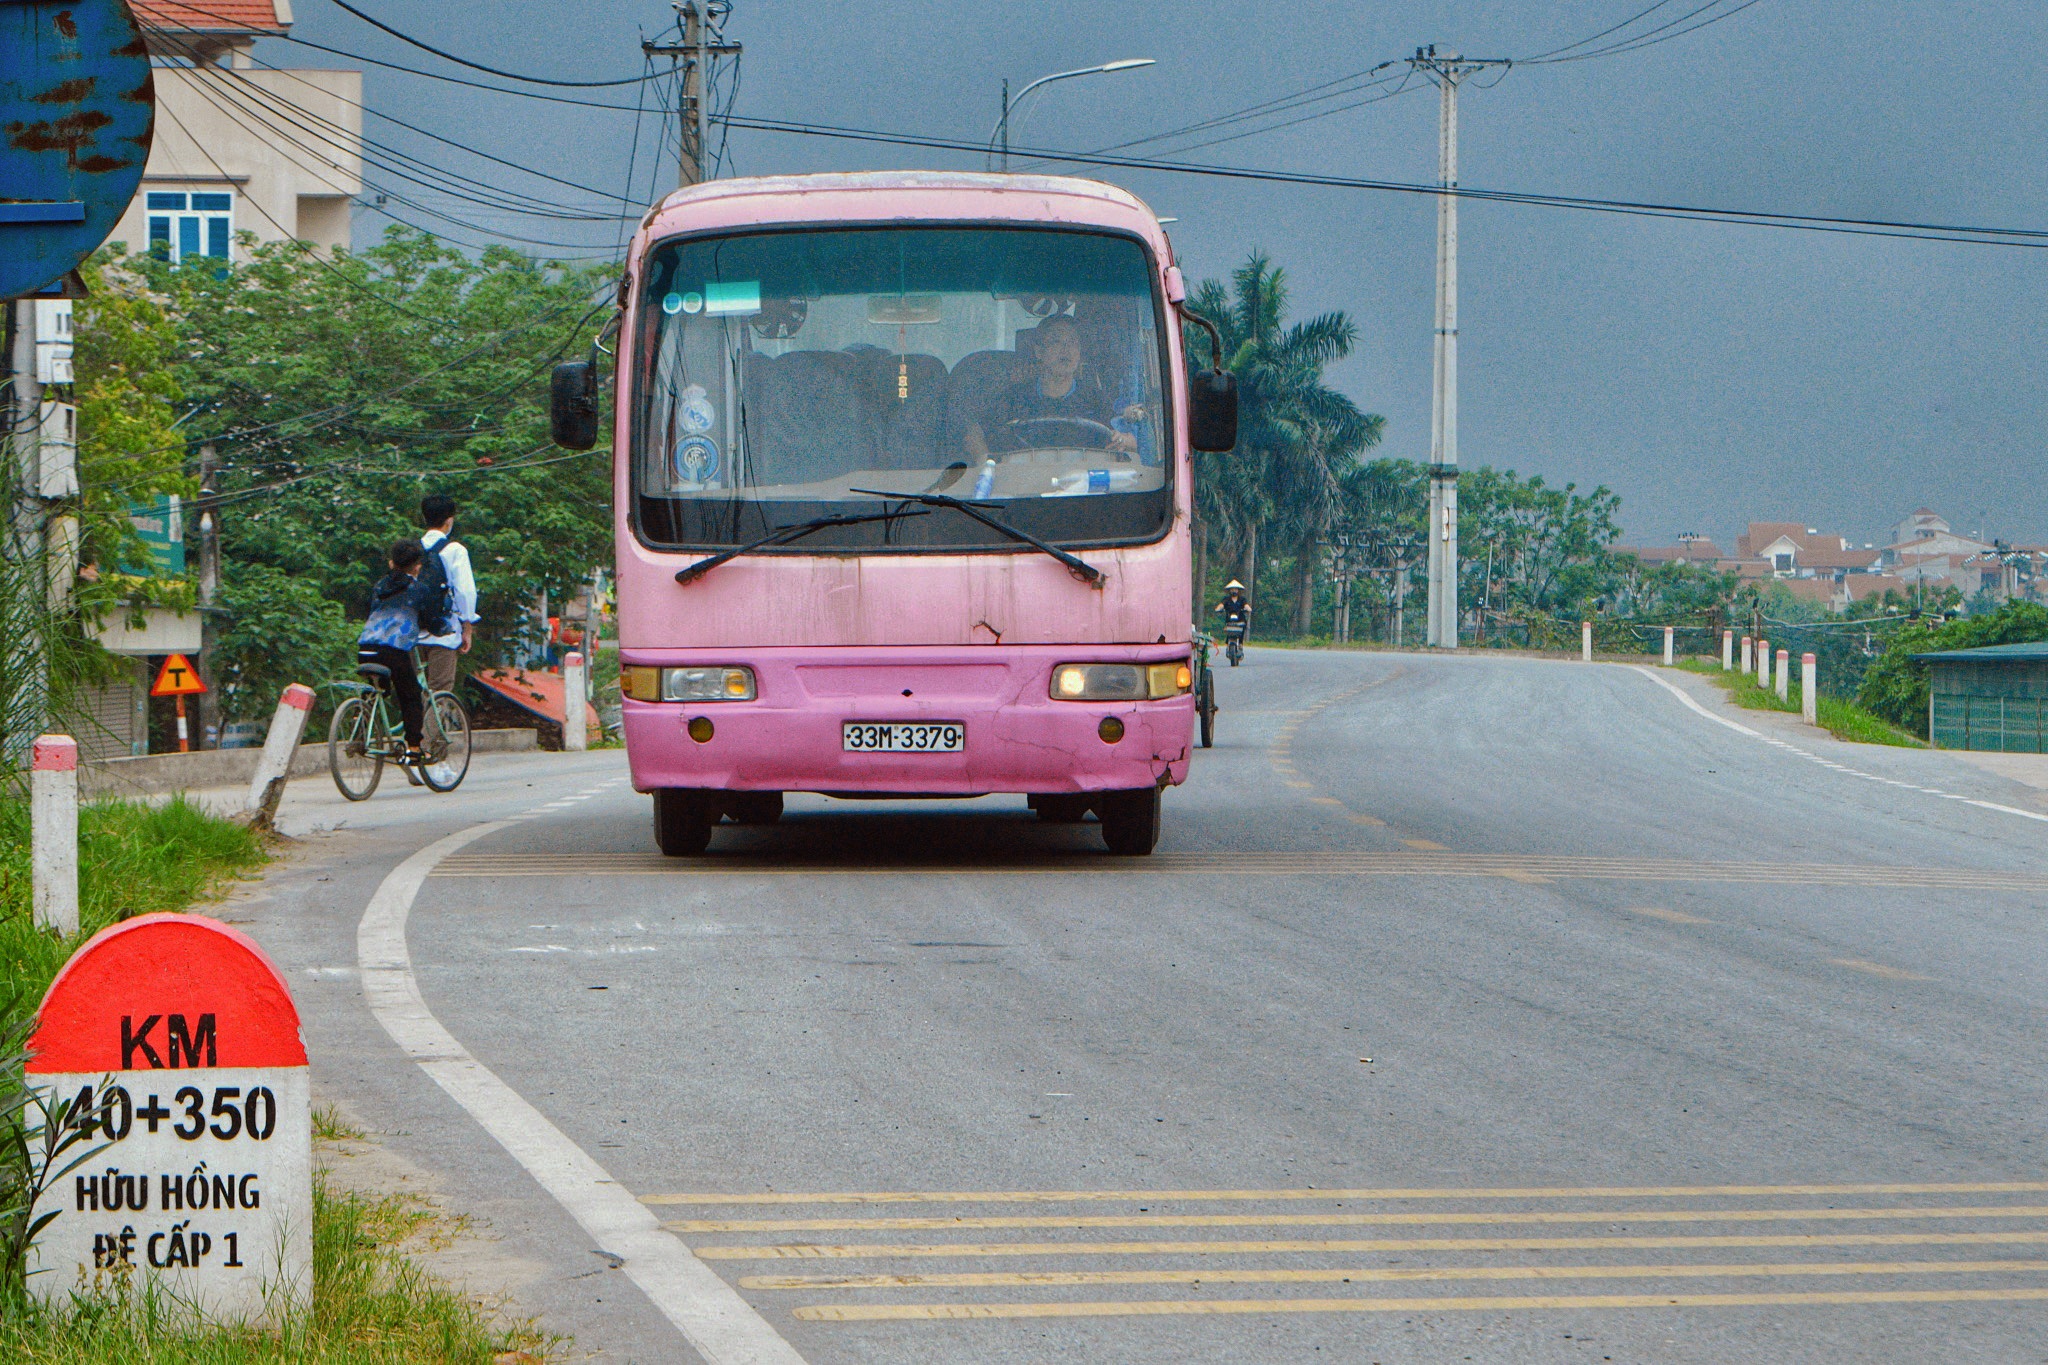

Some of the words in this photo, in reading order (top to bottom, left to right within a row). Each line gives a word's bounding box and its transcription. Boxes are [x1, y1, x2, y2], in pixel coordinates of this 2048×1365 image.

[850, 726, 957, 748] 33M-3379
[121, 1013, 217, 1070] KM
[64, 1085, 276, 1141] 40+350
[76, 1167, 148, 1211] HỮU
[161, 1161, 260, 1210] HỒNG
[93, 1225, 137, 1269] ĐÊ
[148, 1219, 212, 1268] CẤP
[223, 1232, 243, 1268] 1
